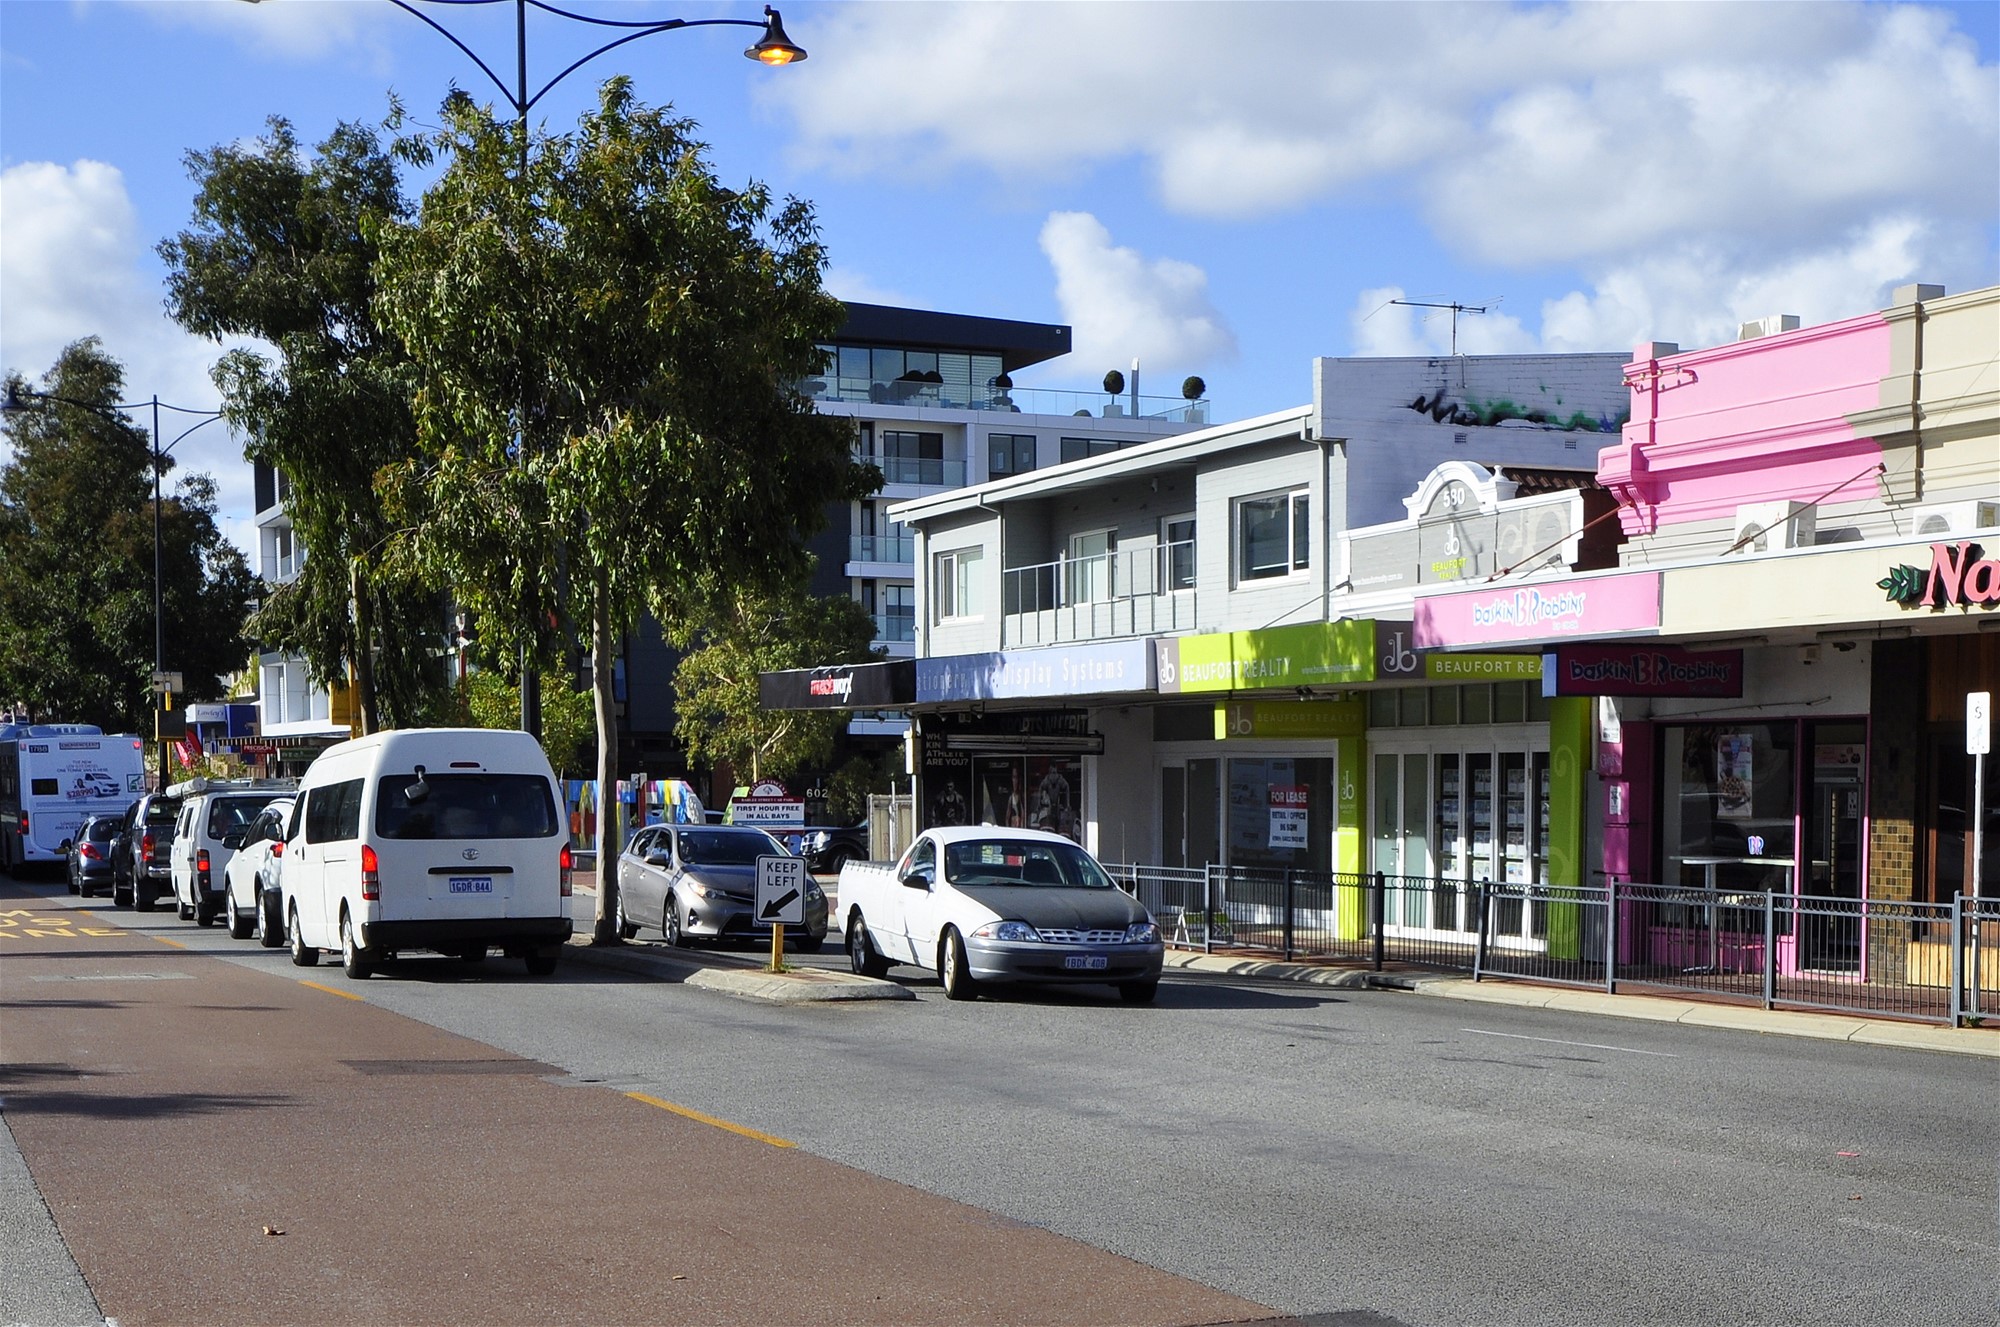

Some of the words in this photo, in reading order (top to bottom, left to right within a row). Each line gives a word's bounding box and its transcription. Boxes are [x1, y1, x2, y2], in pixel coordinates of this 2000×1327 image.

[1443, 487, 1465, 507] 580
[1431, 557, 1468, 572] BEAUFORT
[1473, 599, 1514, 625] baskin
[1515, 588, 1540, 626] BR
[1540, 592, 1586, 619] robbins
[1003, 662, 1051, 689] Display
[1062, 656, 1124, 687] Systems
[1183, 660, 1241, 682] BEAUFORT
[1244, 657, 1291, 678] REALTY
[1436, 661, 1512, 673] BEAUFORT
[1517, 661, 1544, 673] REA
[1570, 659, 1632, 682] baskin
[1632, 652, 1670, 685] BR
[1670, 662, 1731, 683] robbins
[926, 732, 942, 740] WH
[926, 741, 941, 749] KIN
[926, 758, 944, 766] ARE
[945, 758, 969, 766] YOU?
[806, 788, 829, 798] 602
[1271, 791, 1285, 803] FOR
[1286, 791, 1308, 803] LEASE
[767, 862, 798, 873] KEEP
[767, 876, 797, 886] LEFT
